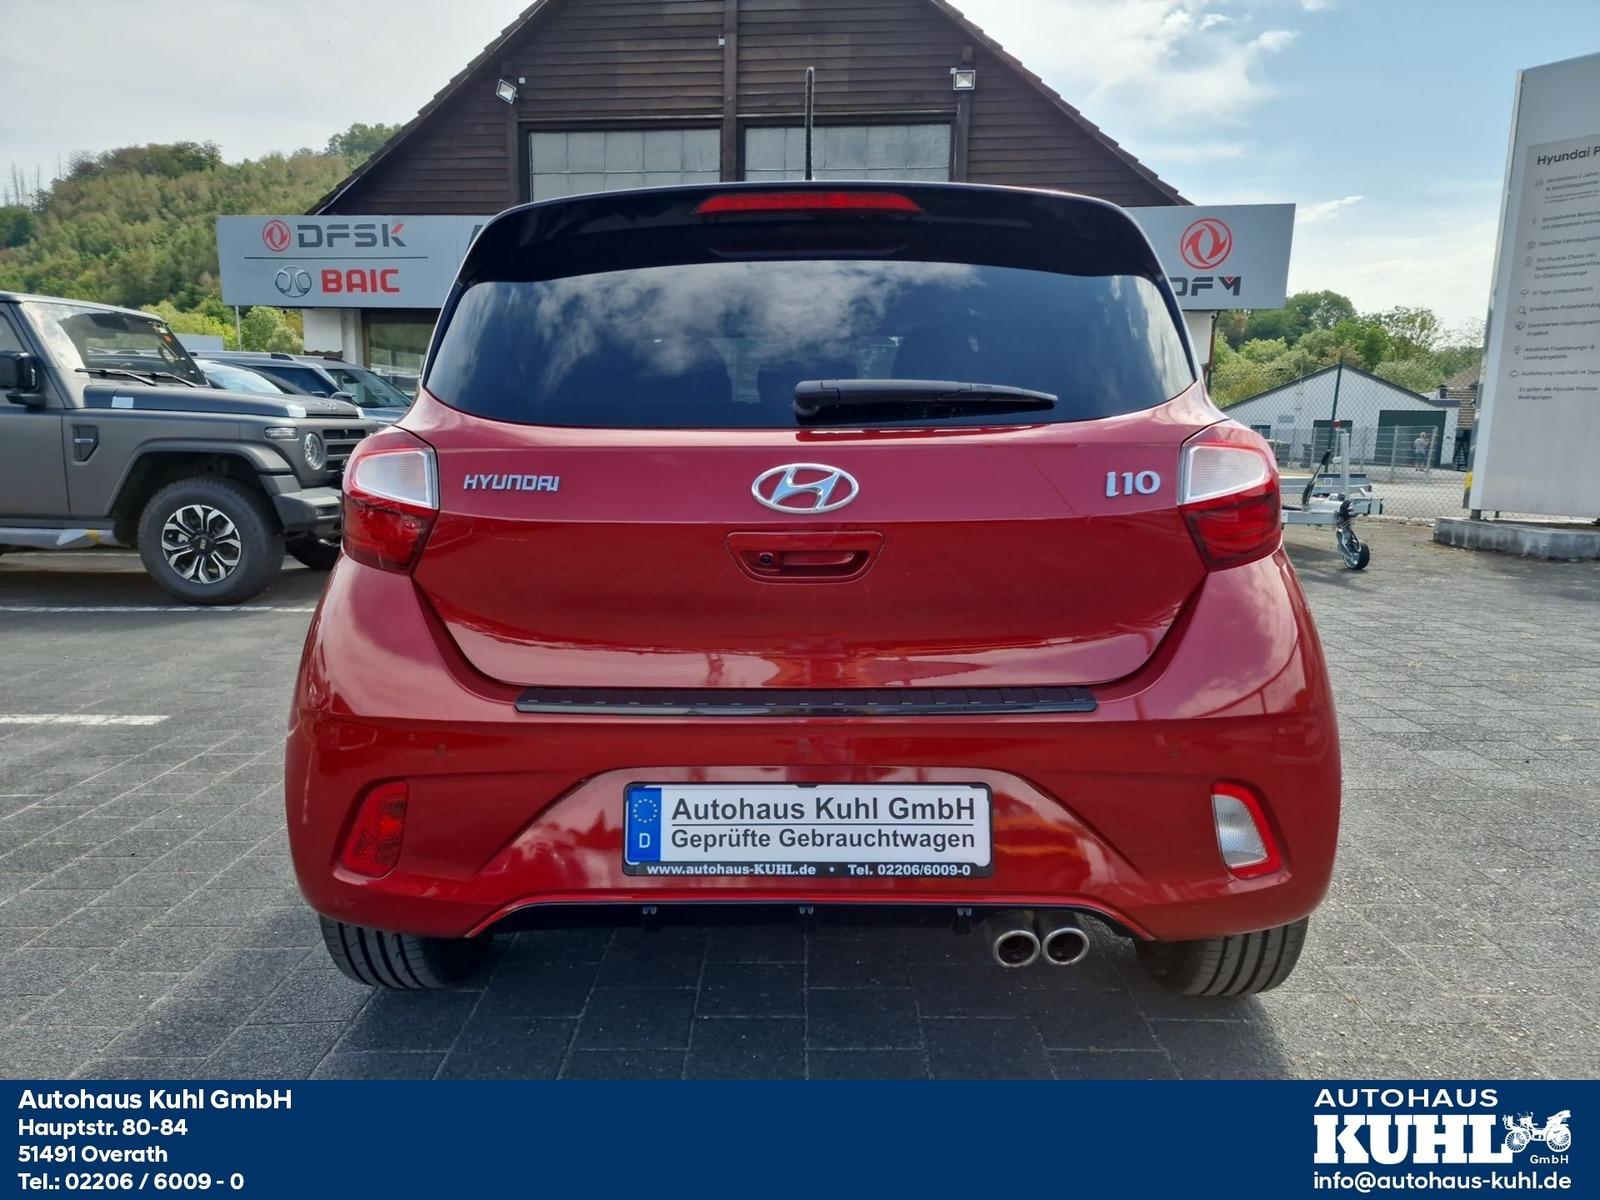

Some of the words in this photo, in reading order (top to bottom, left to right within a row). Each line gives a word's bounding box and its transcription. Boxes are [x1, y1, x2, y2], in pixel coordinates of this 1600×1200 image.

[1537, 147, 1590, 165] Hyundai
[297, 223, 406, 248] DFSK
[321, 269, 399, 293] BAIC
[463, 474, 560, 491] HYUNDAI
[1106, 470, 1161, 497] i10
[672, 798, 804, 820] Autohaus
[816, 797, 877, 819] Kuhl
[889, 797, 974, 819] GmbH
[640, 833, 650, 847] D
[672, 829, 770, 852] Geprüfte
[779, 829, 974, 852] Gebrauchtwagen
[647, 864, 816, 874] www.autohaus-KUHL.de
[848, 865, 872, 875] Tel.
[878, 864, 970, 875] 02206/6009-0
